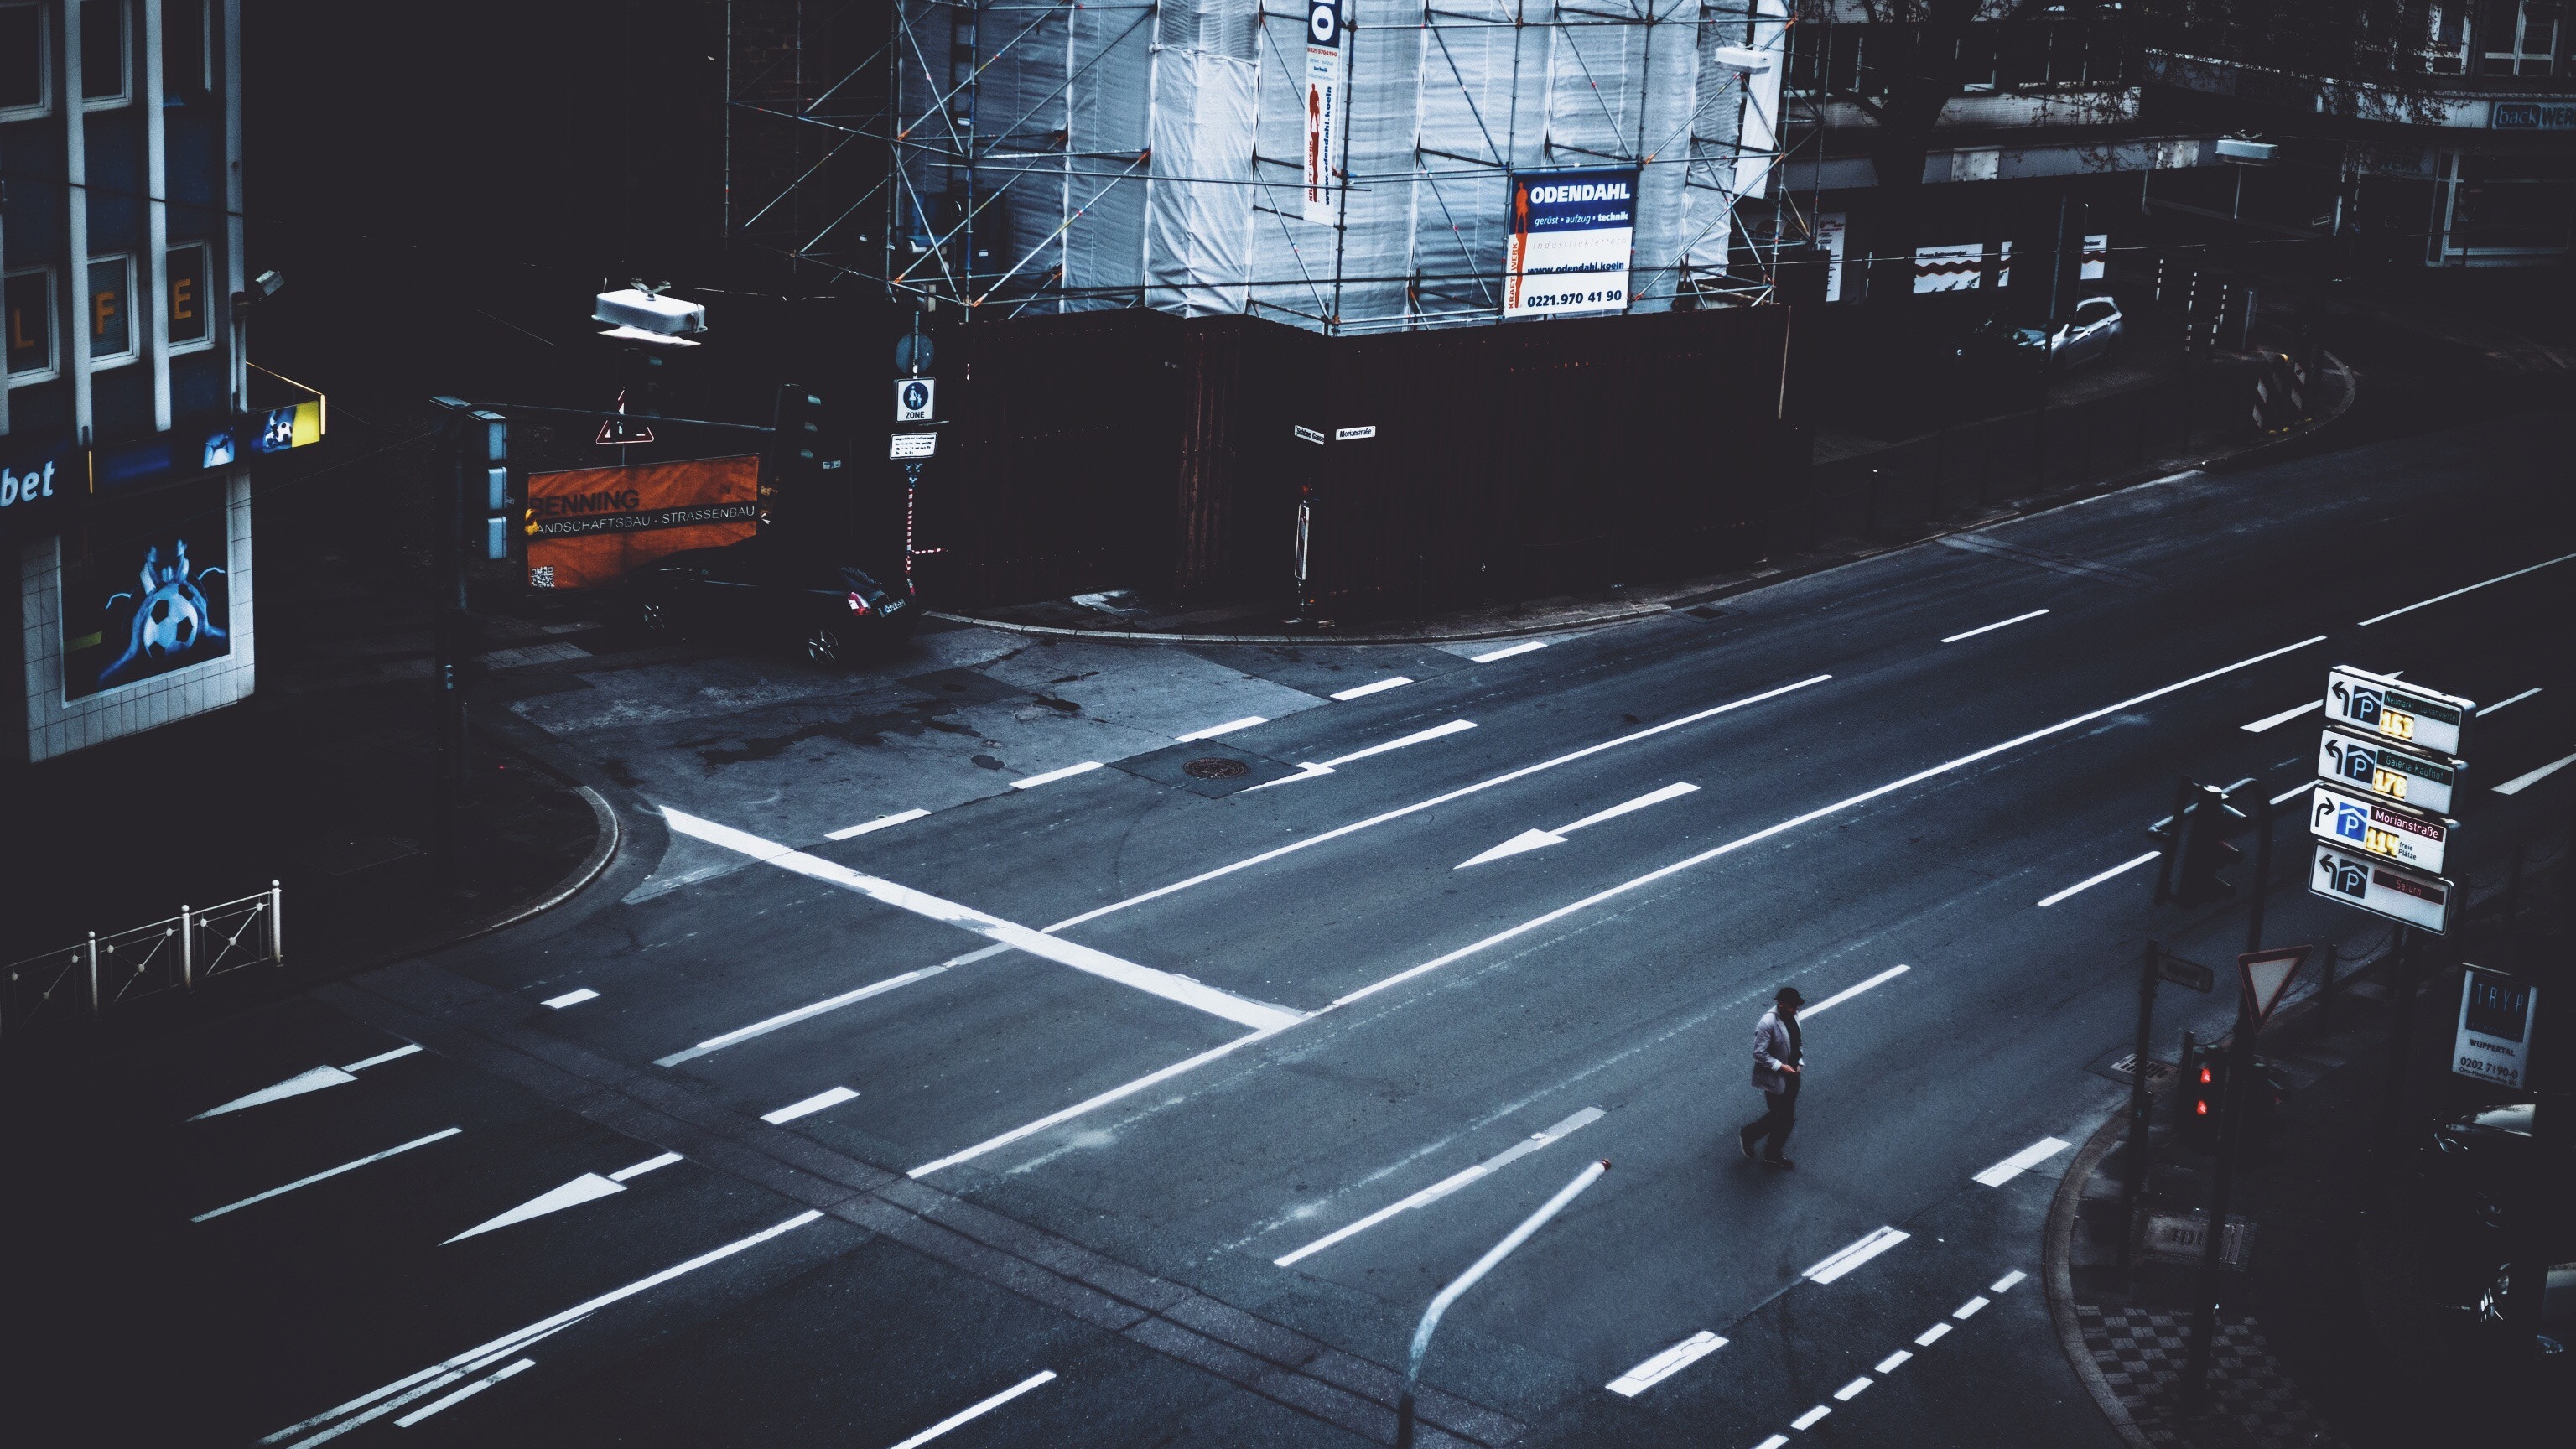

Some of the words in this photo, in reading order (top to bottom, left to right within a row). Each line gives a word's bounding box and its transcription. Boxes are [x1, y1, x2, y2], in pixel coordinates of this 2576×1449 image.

[1530, 183, 1630, 204] ODENDAHL
[1534, 216, 1559, 226] gerüst
[1565, 214, 1591, 225] aufzug
[1597, 211, 1628, 222] technik
[1532, 237, 1627, 250] industrieklettern
[1527, 293, 1584, 308] 0221.970
[1588, 292, 1602, 304] 41
[1607, 290, 1623, 302] 90
[906, 411, 925, 419] ZONE
[0, 460, 55, 507] bet
[531, 515, 652, 534] ANDSCHAFTSBAU
[662, 506, 756, 525] STRASSENBAU
[2381, 711, 2414, 739] 163
[2386, 754, 2412, 772] Galeria
[2413, 761, 2444, 781] Kaufhof
[2375, 809, 2439, 839] Morianstraße
[2398, 849, 2417, 860] Plätze
[2399, 840, 2413, 851] freie
[2396, 878, 2422, 896] Saturn
[2477, 984, 2524, 1015] TRYP
[2470, 1038, 2516, 1057] WUPPERTAL
[2460, 1057, 2483, 1071] 0202
[2486, 1062, 2518, 1080] 7190-0
